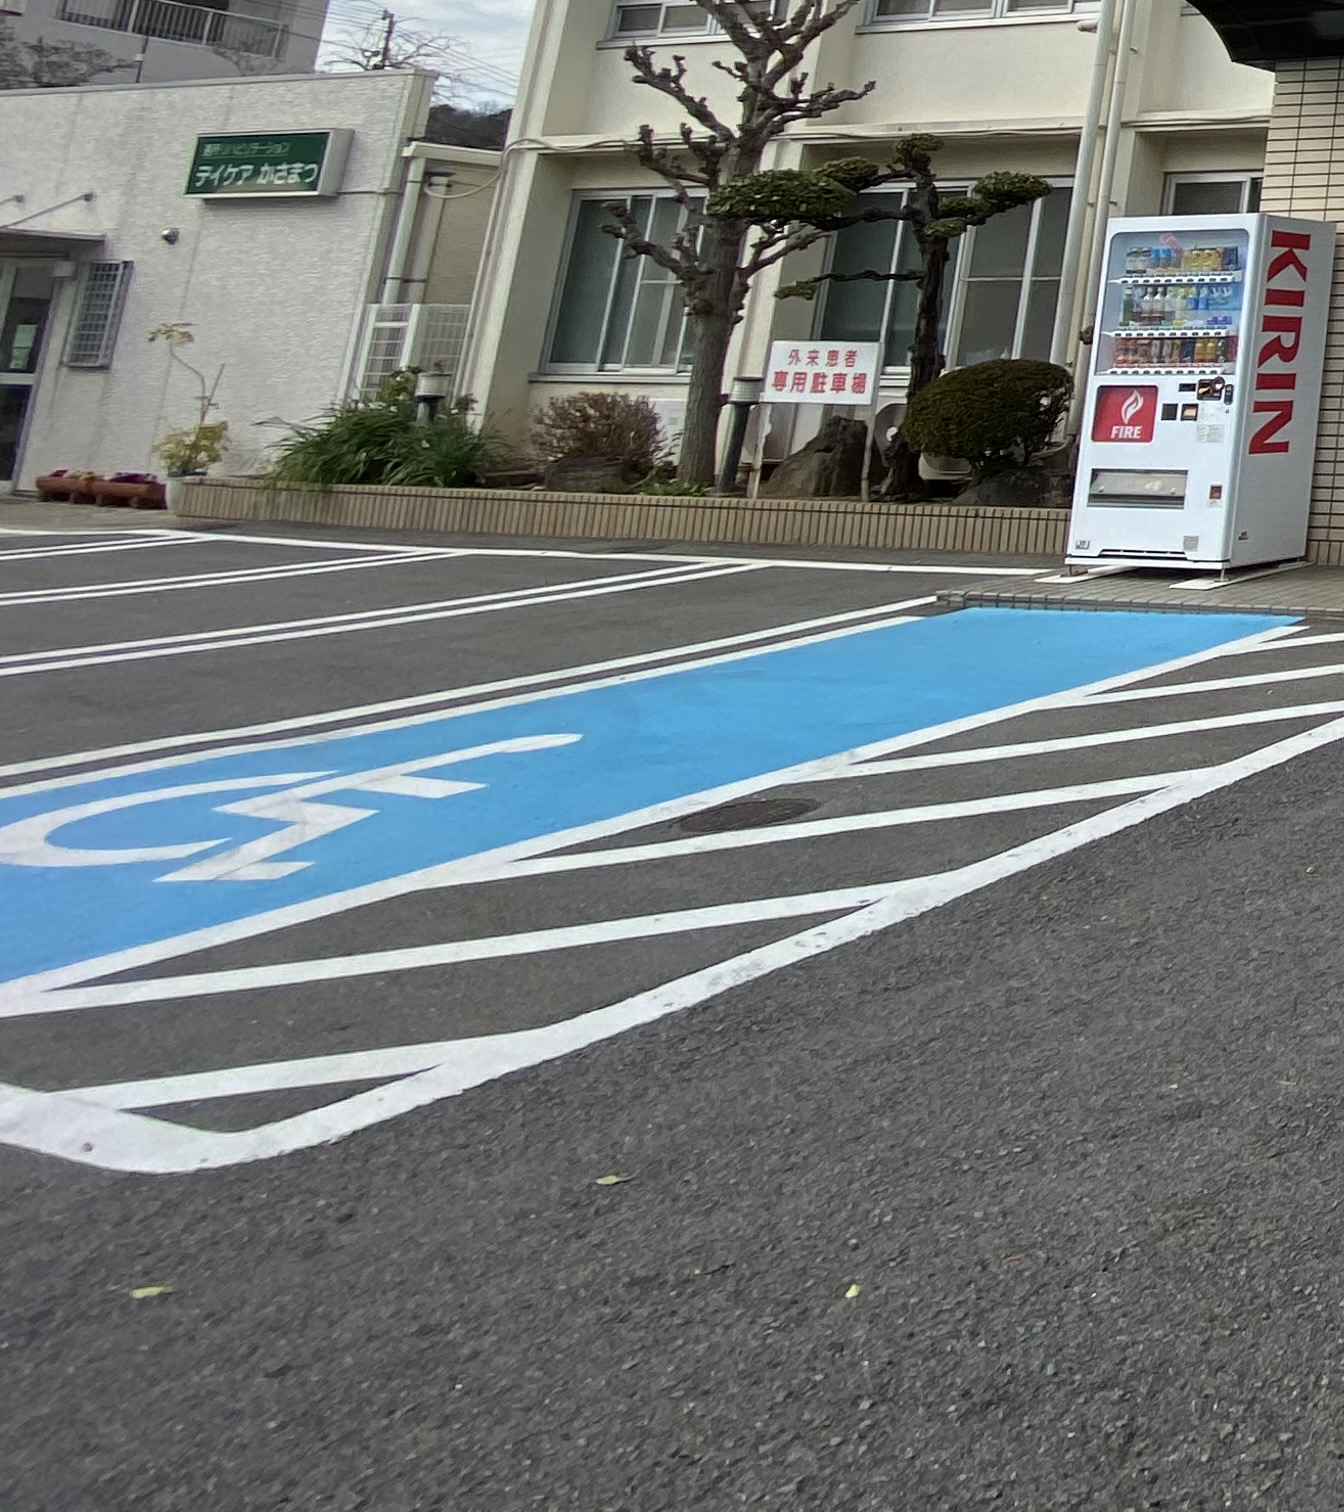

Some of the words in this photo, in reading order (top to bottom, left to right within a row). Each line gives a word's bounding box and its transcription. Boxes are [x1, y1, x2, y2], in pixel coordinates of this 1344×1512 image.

[1248, 229, 1312, 455] KIRIN
[788, 349, 858, 368] 外来患者
[1110, 425, 1143, 439] FIRE
